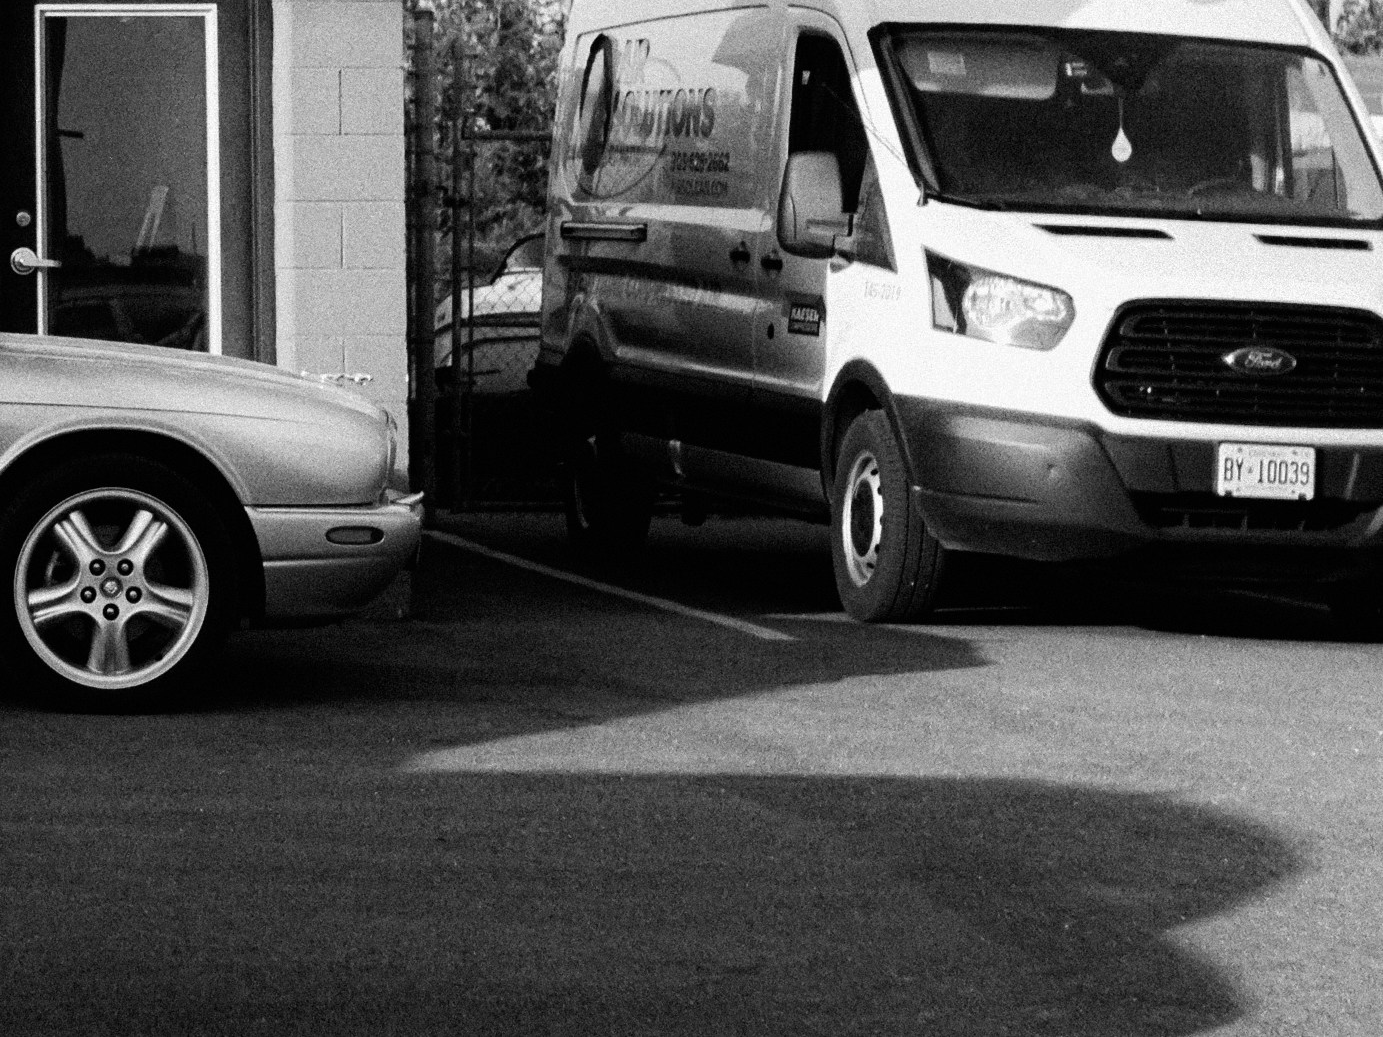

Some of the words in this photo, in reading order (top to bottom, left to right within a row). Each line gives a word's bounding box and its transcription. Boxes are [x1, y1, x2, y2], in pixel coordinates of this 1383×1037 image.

[1244, 351, 1283, 369] Ford
[1224, 457, 1243, 481] BY
[1257, 459, 1310, 486] 10039
